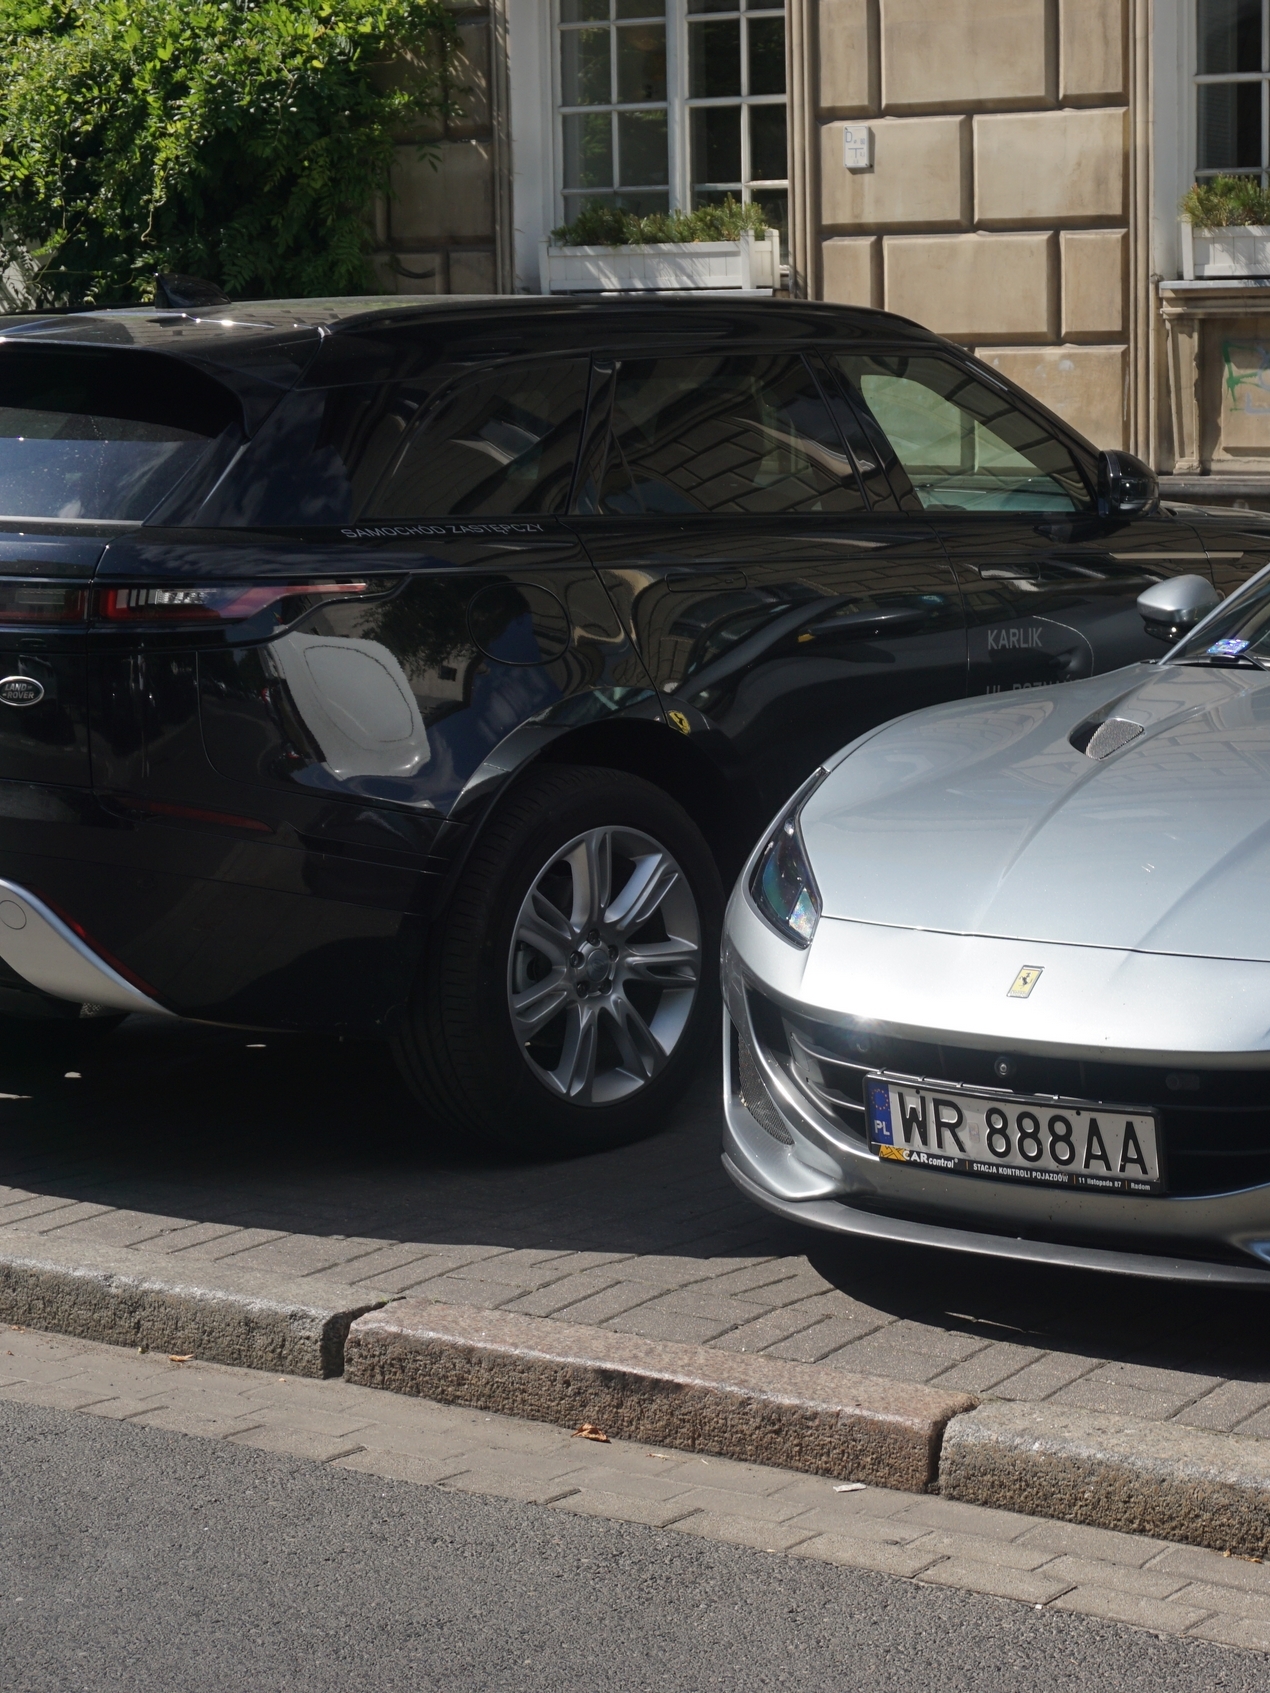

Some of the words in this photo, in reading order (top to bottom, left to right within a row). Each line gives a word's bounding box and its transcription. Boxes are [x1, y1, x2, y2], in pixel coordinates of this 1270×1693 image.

[340, 524, 446, 538] SAMOCHÓD
[447, 523, 544, 535] ZASTĘPCZY
[987, 627, 1043, 650] KARLIK
[5, 683, 27, 691] LAND
[874, 1119, 890, 1136] PL
[896, 1090, 967, 1153] WR
[985, 1106, 1149, 1175] 888AA
[973, 1163, 997, 1174] STACJA
[998, 1166, 1030, 1178] KONTROLI
[1032, 1170, 1069, 1183] POJAZDÓW
[1087, 1178, 1113, 1187] listopada
[1130, 1182, 1151, 1191] Radom
